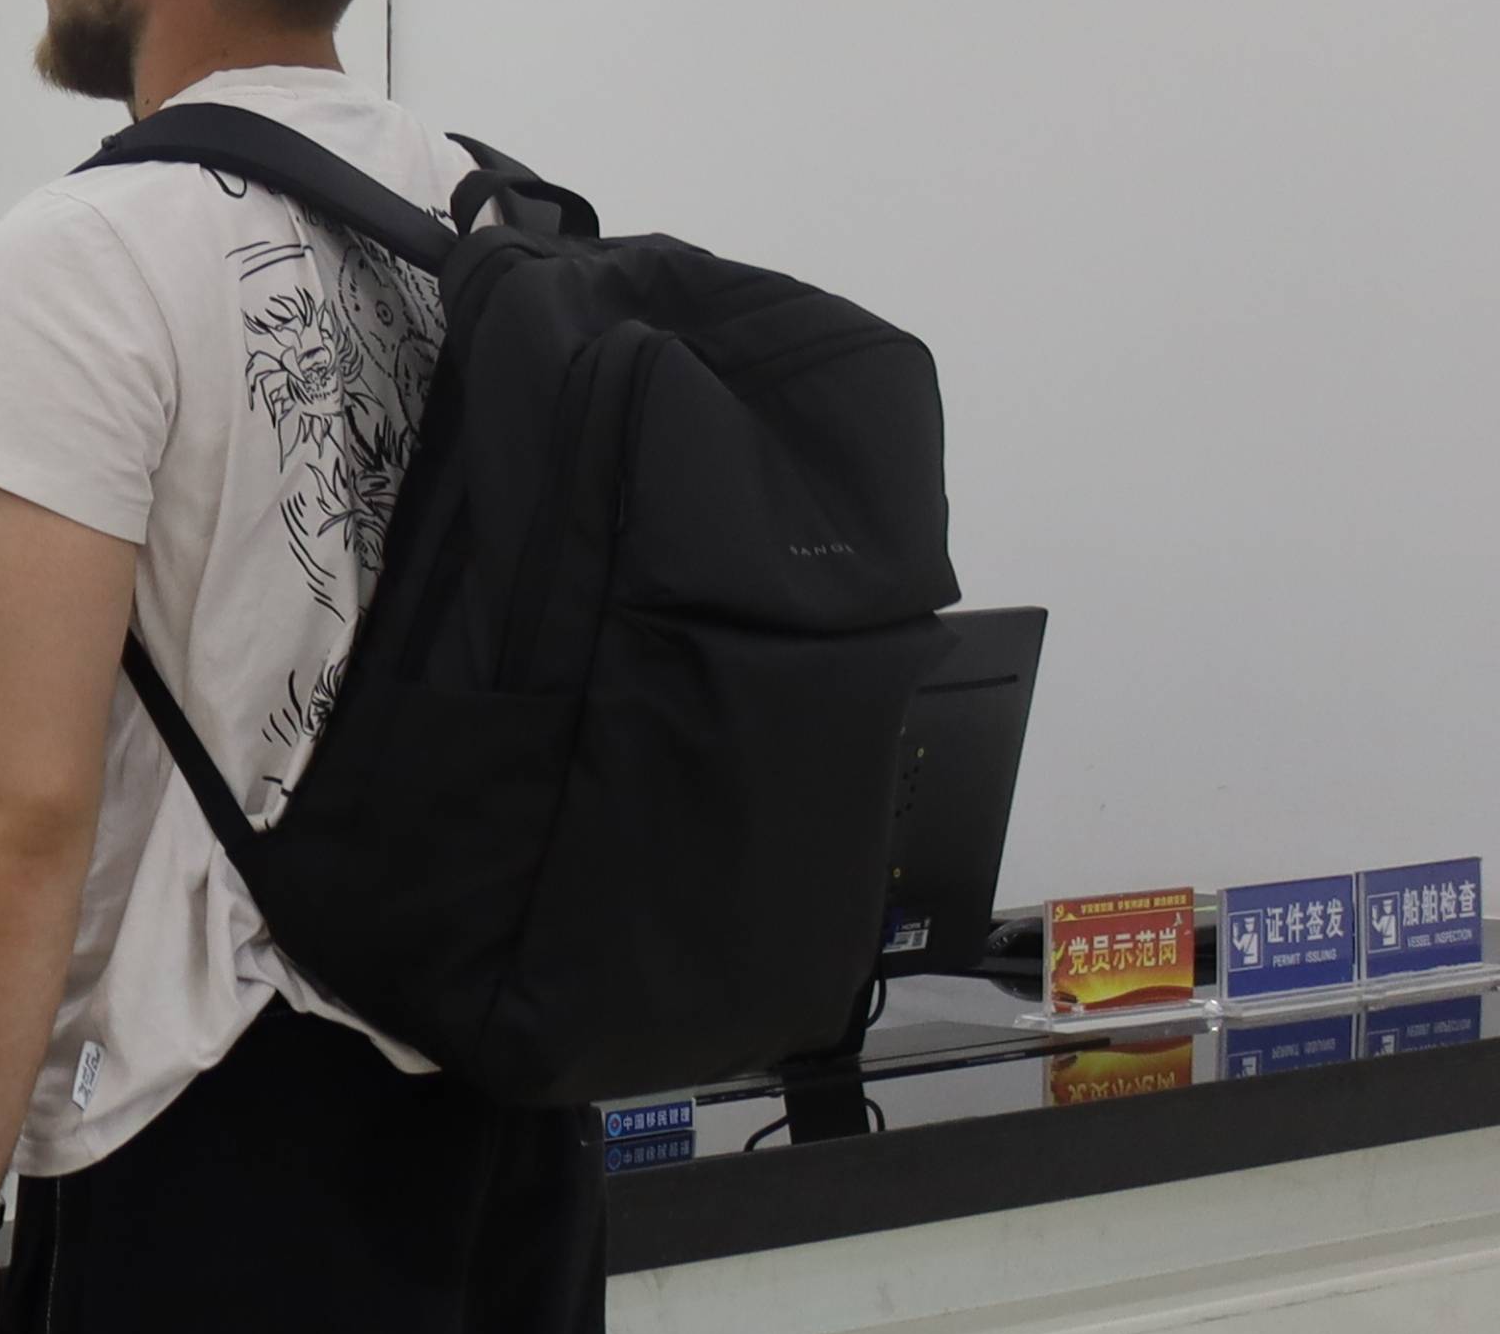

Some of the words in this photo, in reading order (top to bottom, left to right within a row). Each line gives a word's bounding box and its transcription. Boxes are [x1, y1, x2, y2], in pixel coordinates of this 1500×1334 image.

[1266, 898, 1344, 944] 证件签发
[1402, 880, 1476, 927] 船舶检查
[1068, 927, 1177, 975] 党员示范岗
[1407, 934, 1432, 948] VESSEL
[1435, 929, 1473, 945] INSPECTION
[1272, 952, 1301, 967] PERMIT
[622, 1107, 691, 1131] 中国移民管理
